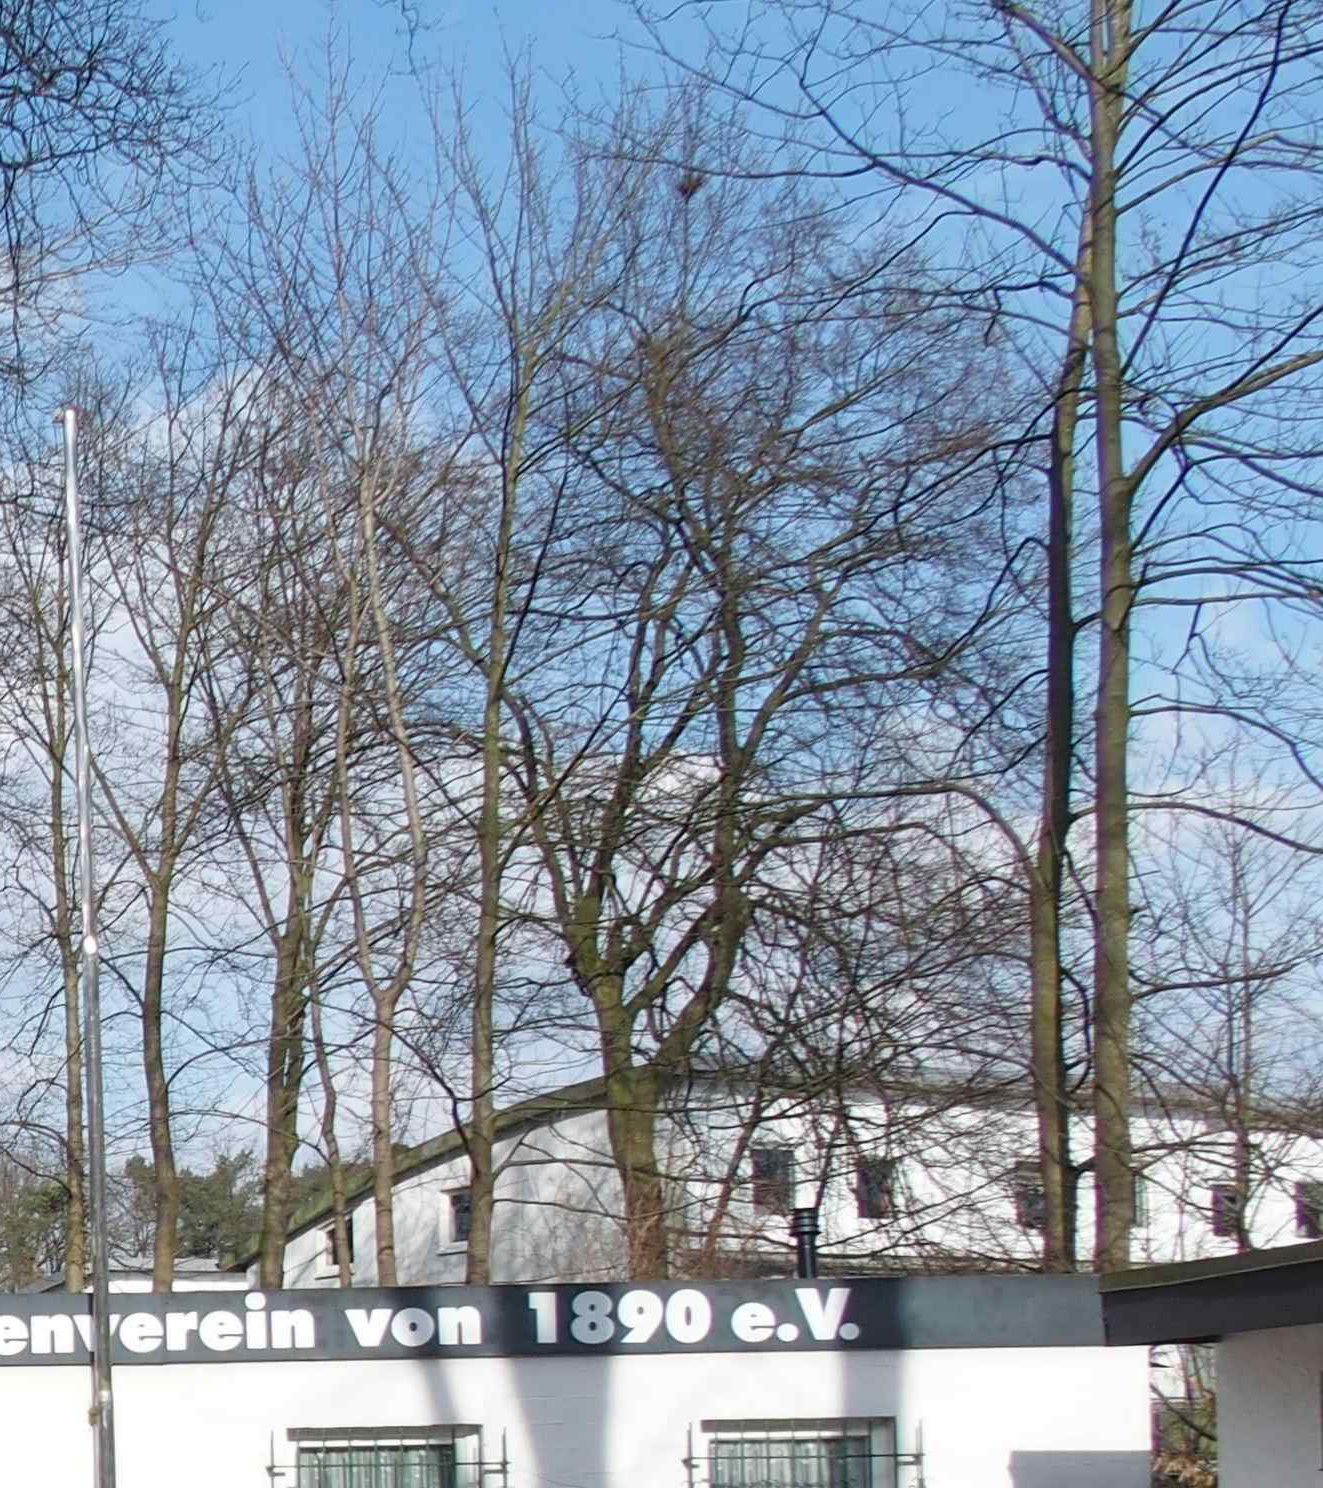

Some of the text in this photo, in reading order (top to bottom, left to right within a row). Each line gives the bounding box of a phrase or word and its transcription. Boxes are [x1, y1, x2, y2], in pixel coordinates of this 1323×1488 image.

[345, 1304, 483, 1346] von
[529, 1289, 713, 1345] 1890
[731, 1288, 862, 1342] e.V.
